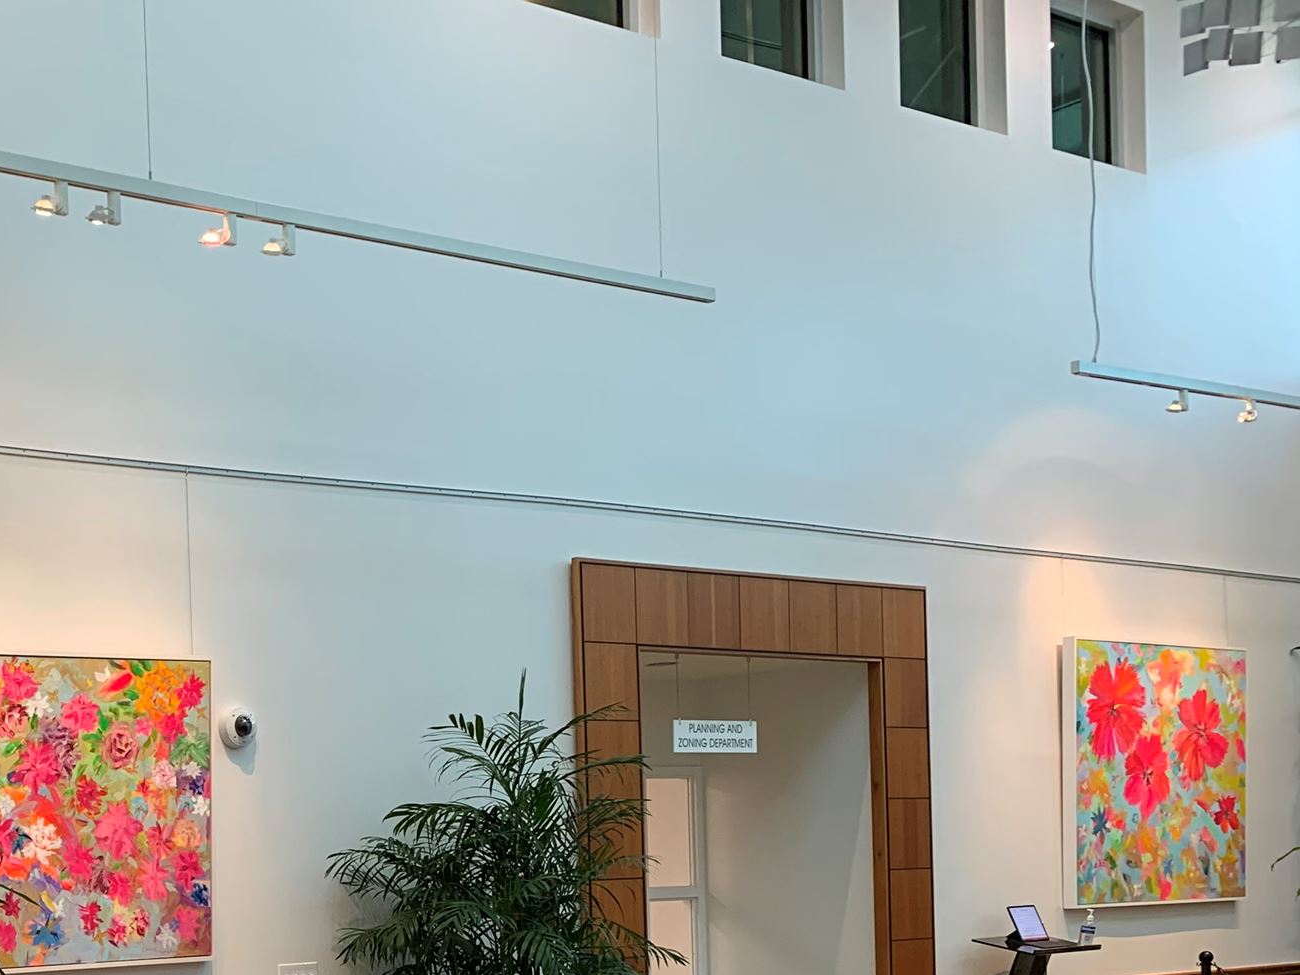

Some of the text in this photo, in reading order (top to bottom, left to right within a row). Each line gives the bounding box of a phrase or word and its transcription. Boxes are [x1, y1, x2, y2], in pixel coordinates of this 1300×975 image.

[688, 723, 743, 734] PLANNING AND
[678, 738, 754, 748] ZONING DEPARTMENT
